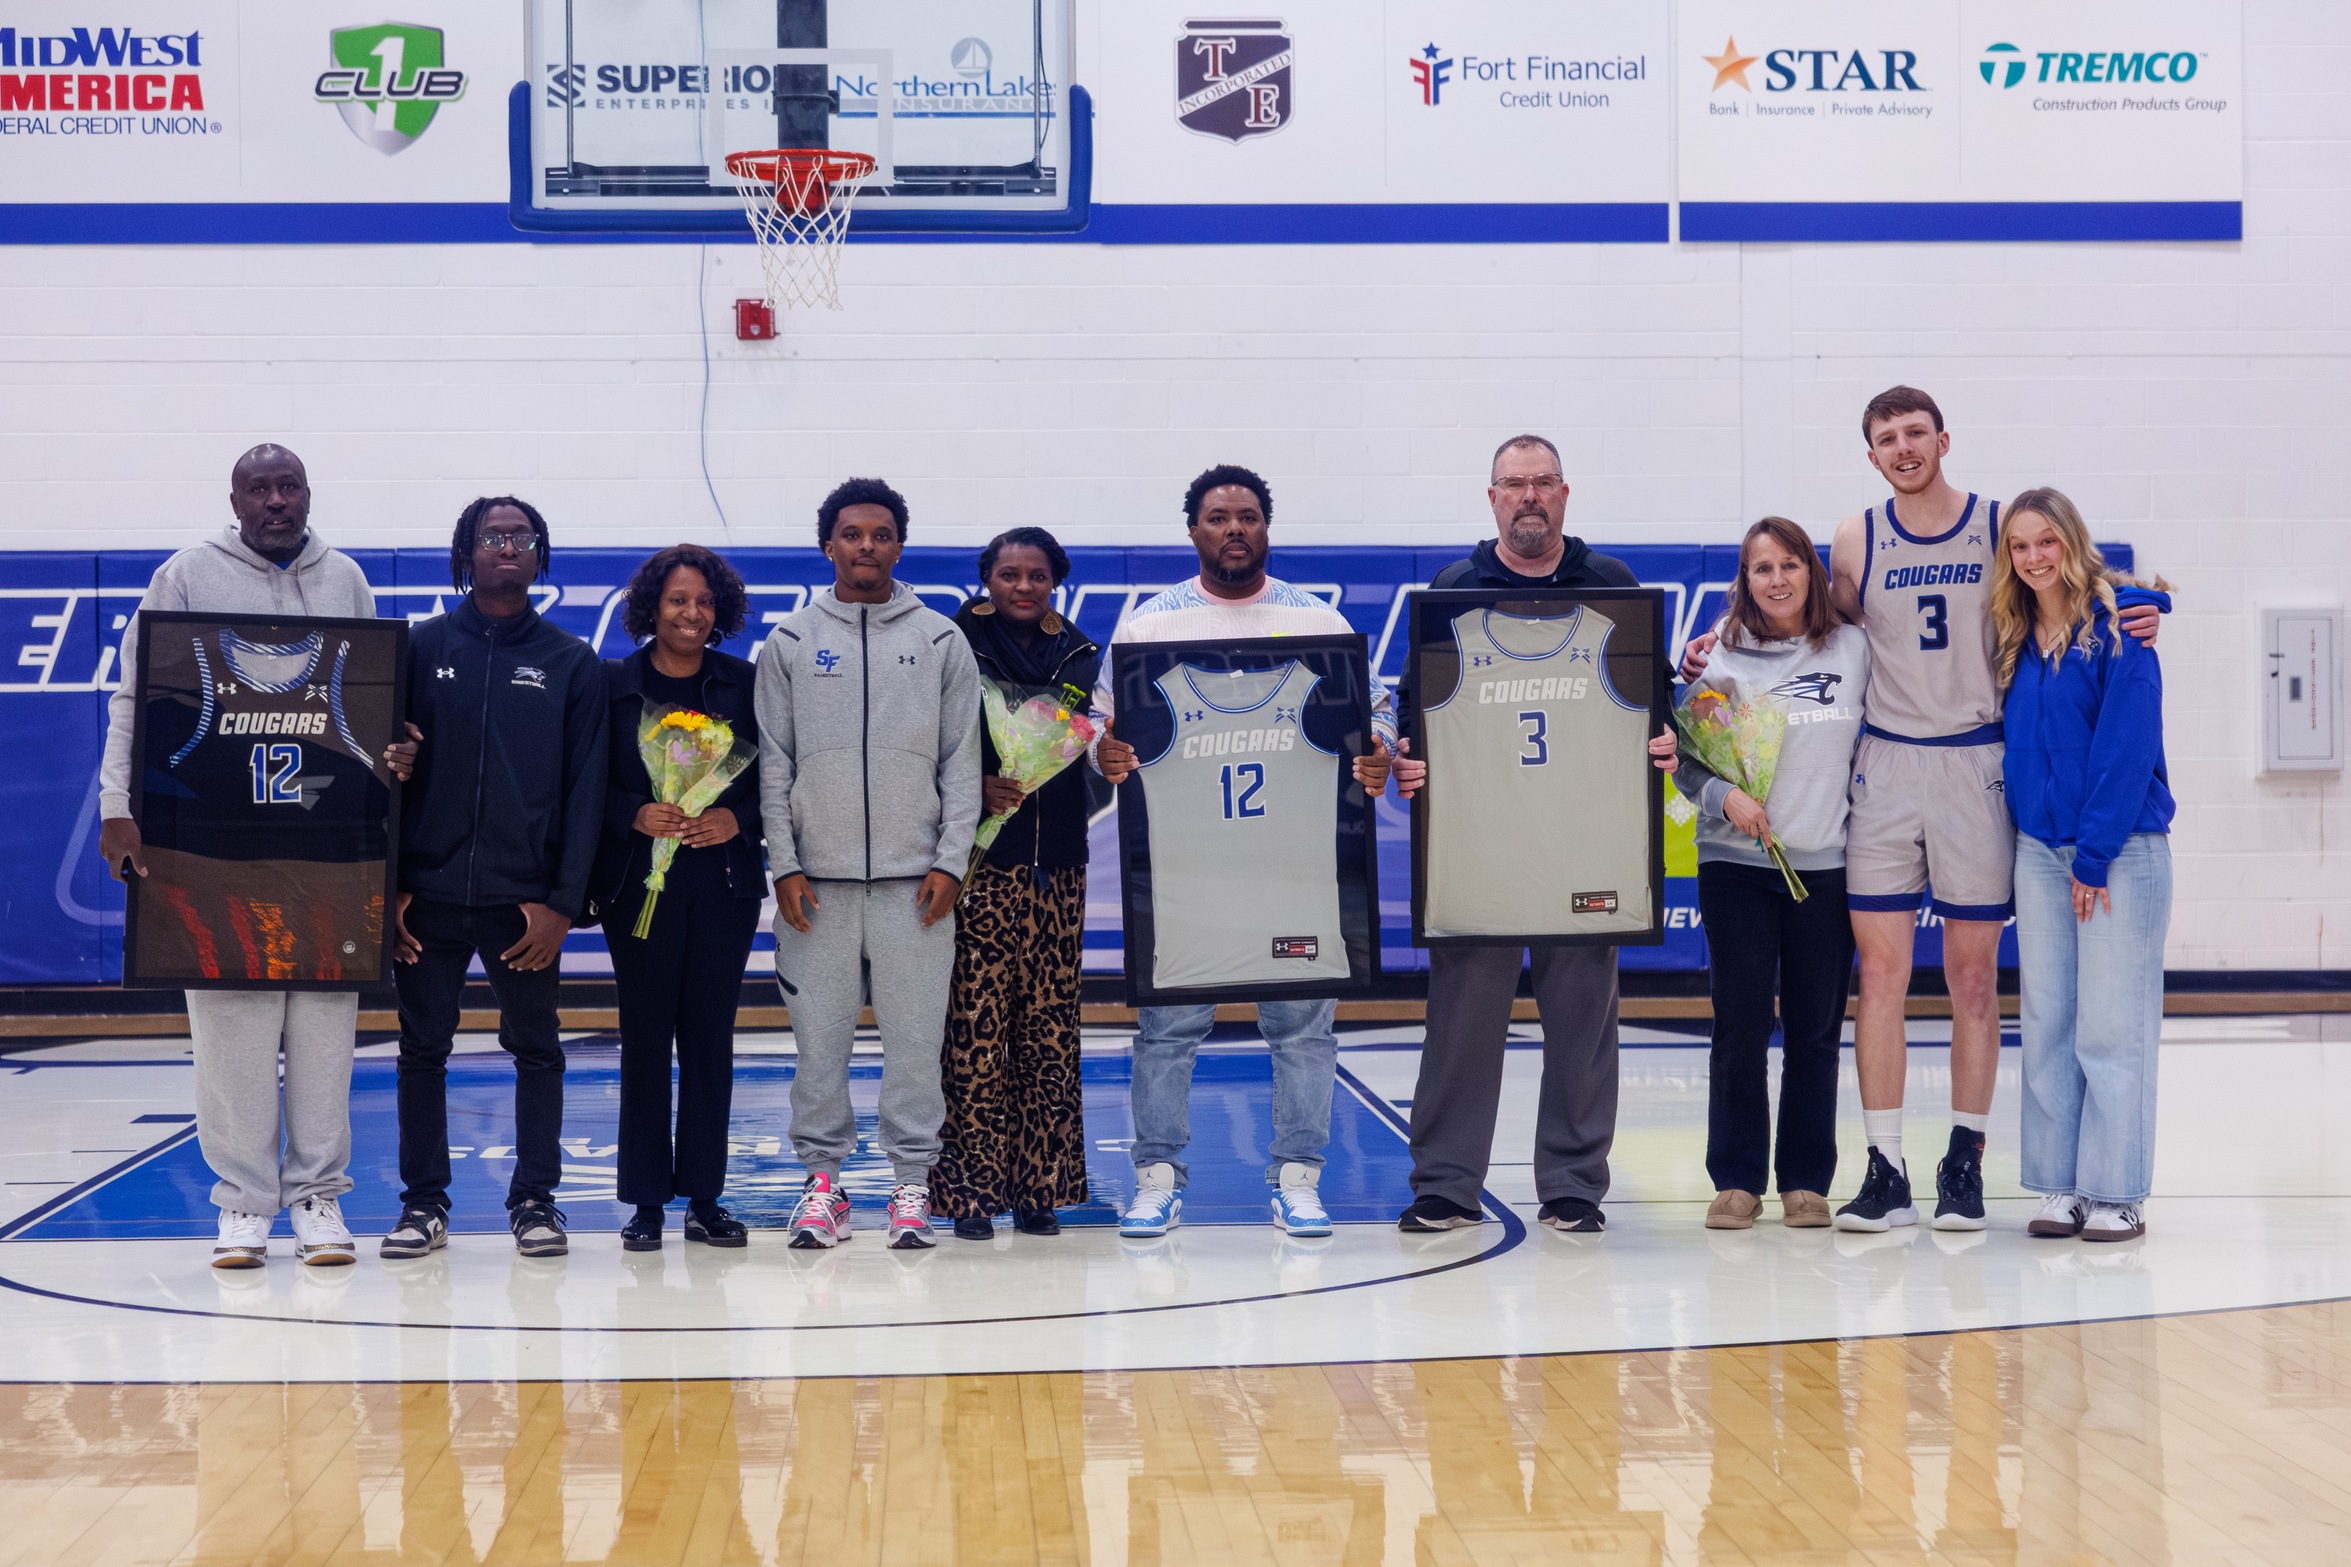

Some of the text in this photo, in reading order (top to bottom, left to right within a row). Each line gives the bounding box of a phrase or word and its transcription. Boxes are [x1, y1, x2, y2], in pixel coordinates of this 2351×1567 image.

[597, 64, 777, 94] SUPEIO
[1463, 55, 1646, 81] Fort Financial
[1766, 49, 1929, 92] STAR
[2036, 52, 2198, 83] TREMCO
[0, 74, 204, 112] MERICA
[315, 71, 464, 97] CLUB
[986, 68, 1057, 97] Lake
[1178, 53, 1292, 115] INCORPORATED
[596, 99, 751, 110] ENTERPRIES
[1500, 90, 1610, 108] Credit Union
[1709, 101, 1740, 116] Bank
[1756, 102, 1816, 116] Insurance
[1832, 101, 1933, 119] Private Advisory
[2032, 96, 2227, 114] Construction Products Group
[60, 117, 136, 135] CREDIT
[1884, 563, 1984, 591] COUGARS
[1917, 593, 1949, 651] 3
[815, 649, 841, 673] SF
[1478, 677, 1588, 704] COUGARS
[218, 712, 328, 735] COUGARS
[1787, 706, 1855, 726] ETBALL
[1182, 728, 1296, 760] COUGARS
[1517, 709, 1549, 768] 3
[249, 743, 302, 804] 12
[1217, 761, 1267, 821] 12
